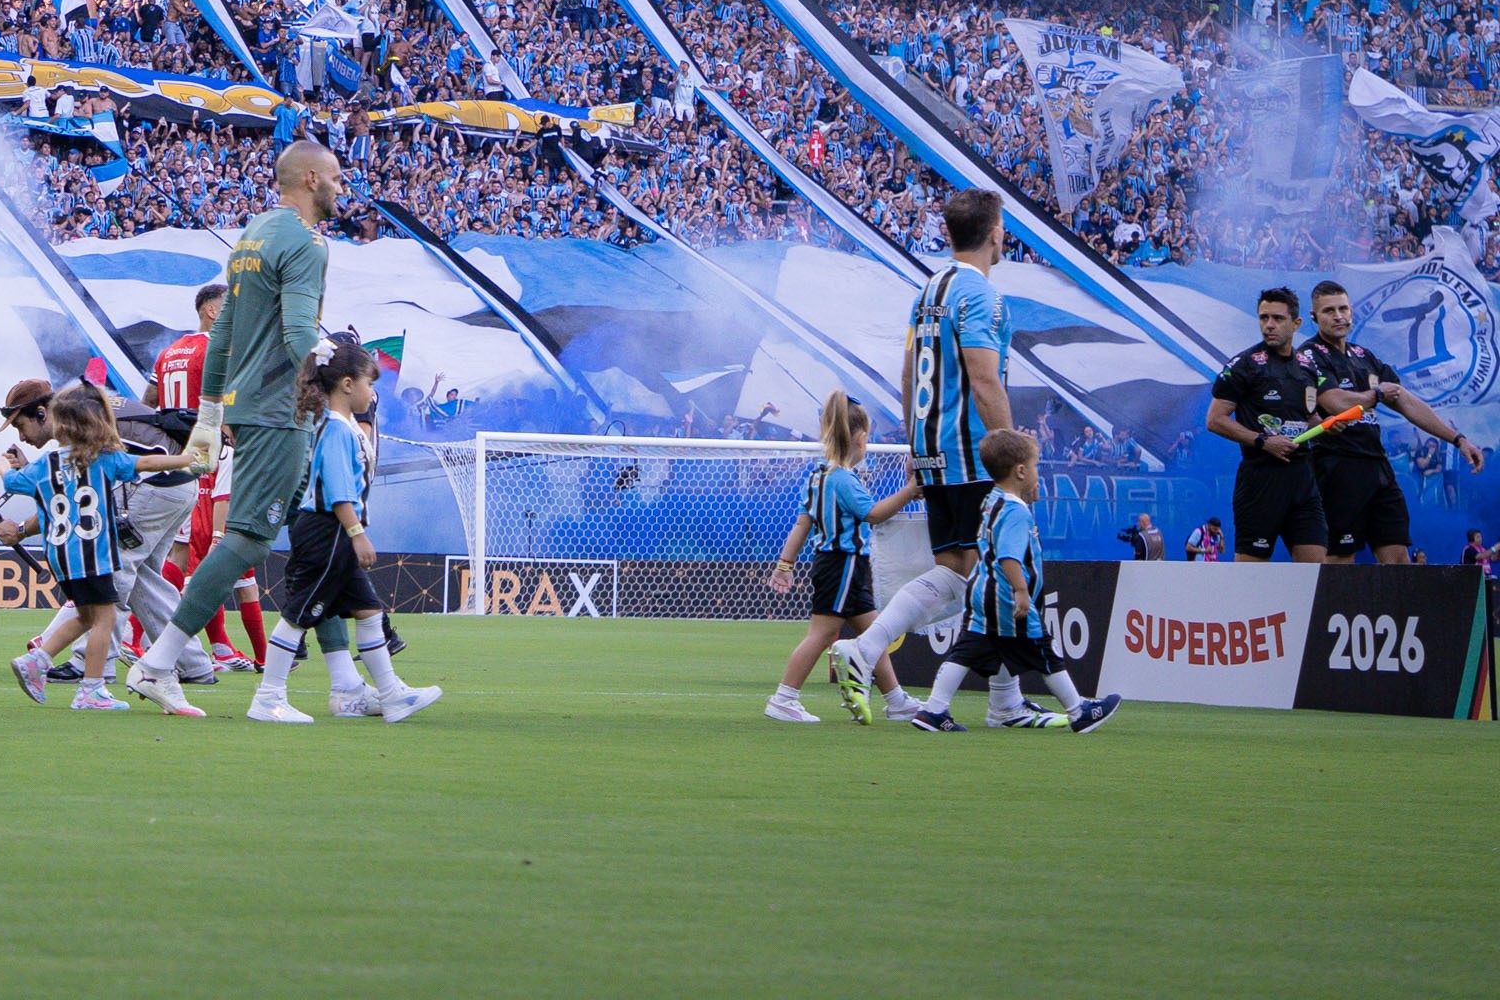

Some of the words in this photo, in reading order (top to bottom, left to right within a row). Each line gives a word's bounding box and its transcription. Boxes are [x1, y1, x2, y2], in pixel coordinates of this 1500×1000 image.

[1038, 31, 1122, 63] JOVEM
[915, 346, 935, 420] 8
[912, 452, 948, 470] nimed
[47, 485, 103, 546] 83
[461, 569, 601, 618] BRAX
[1124, 609, 1286, 666] SUPERBET
[1328, 614, 1425, 674] 2026
